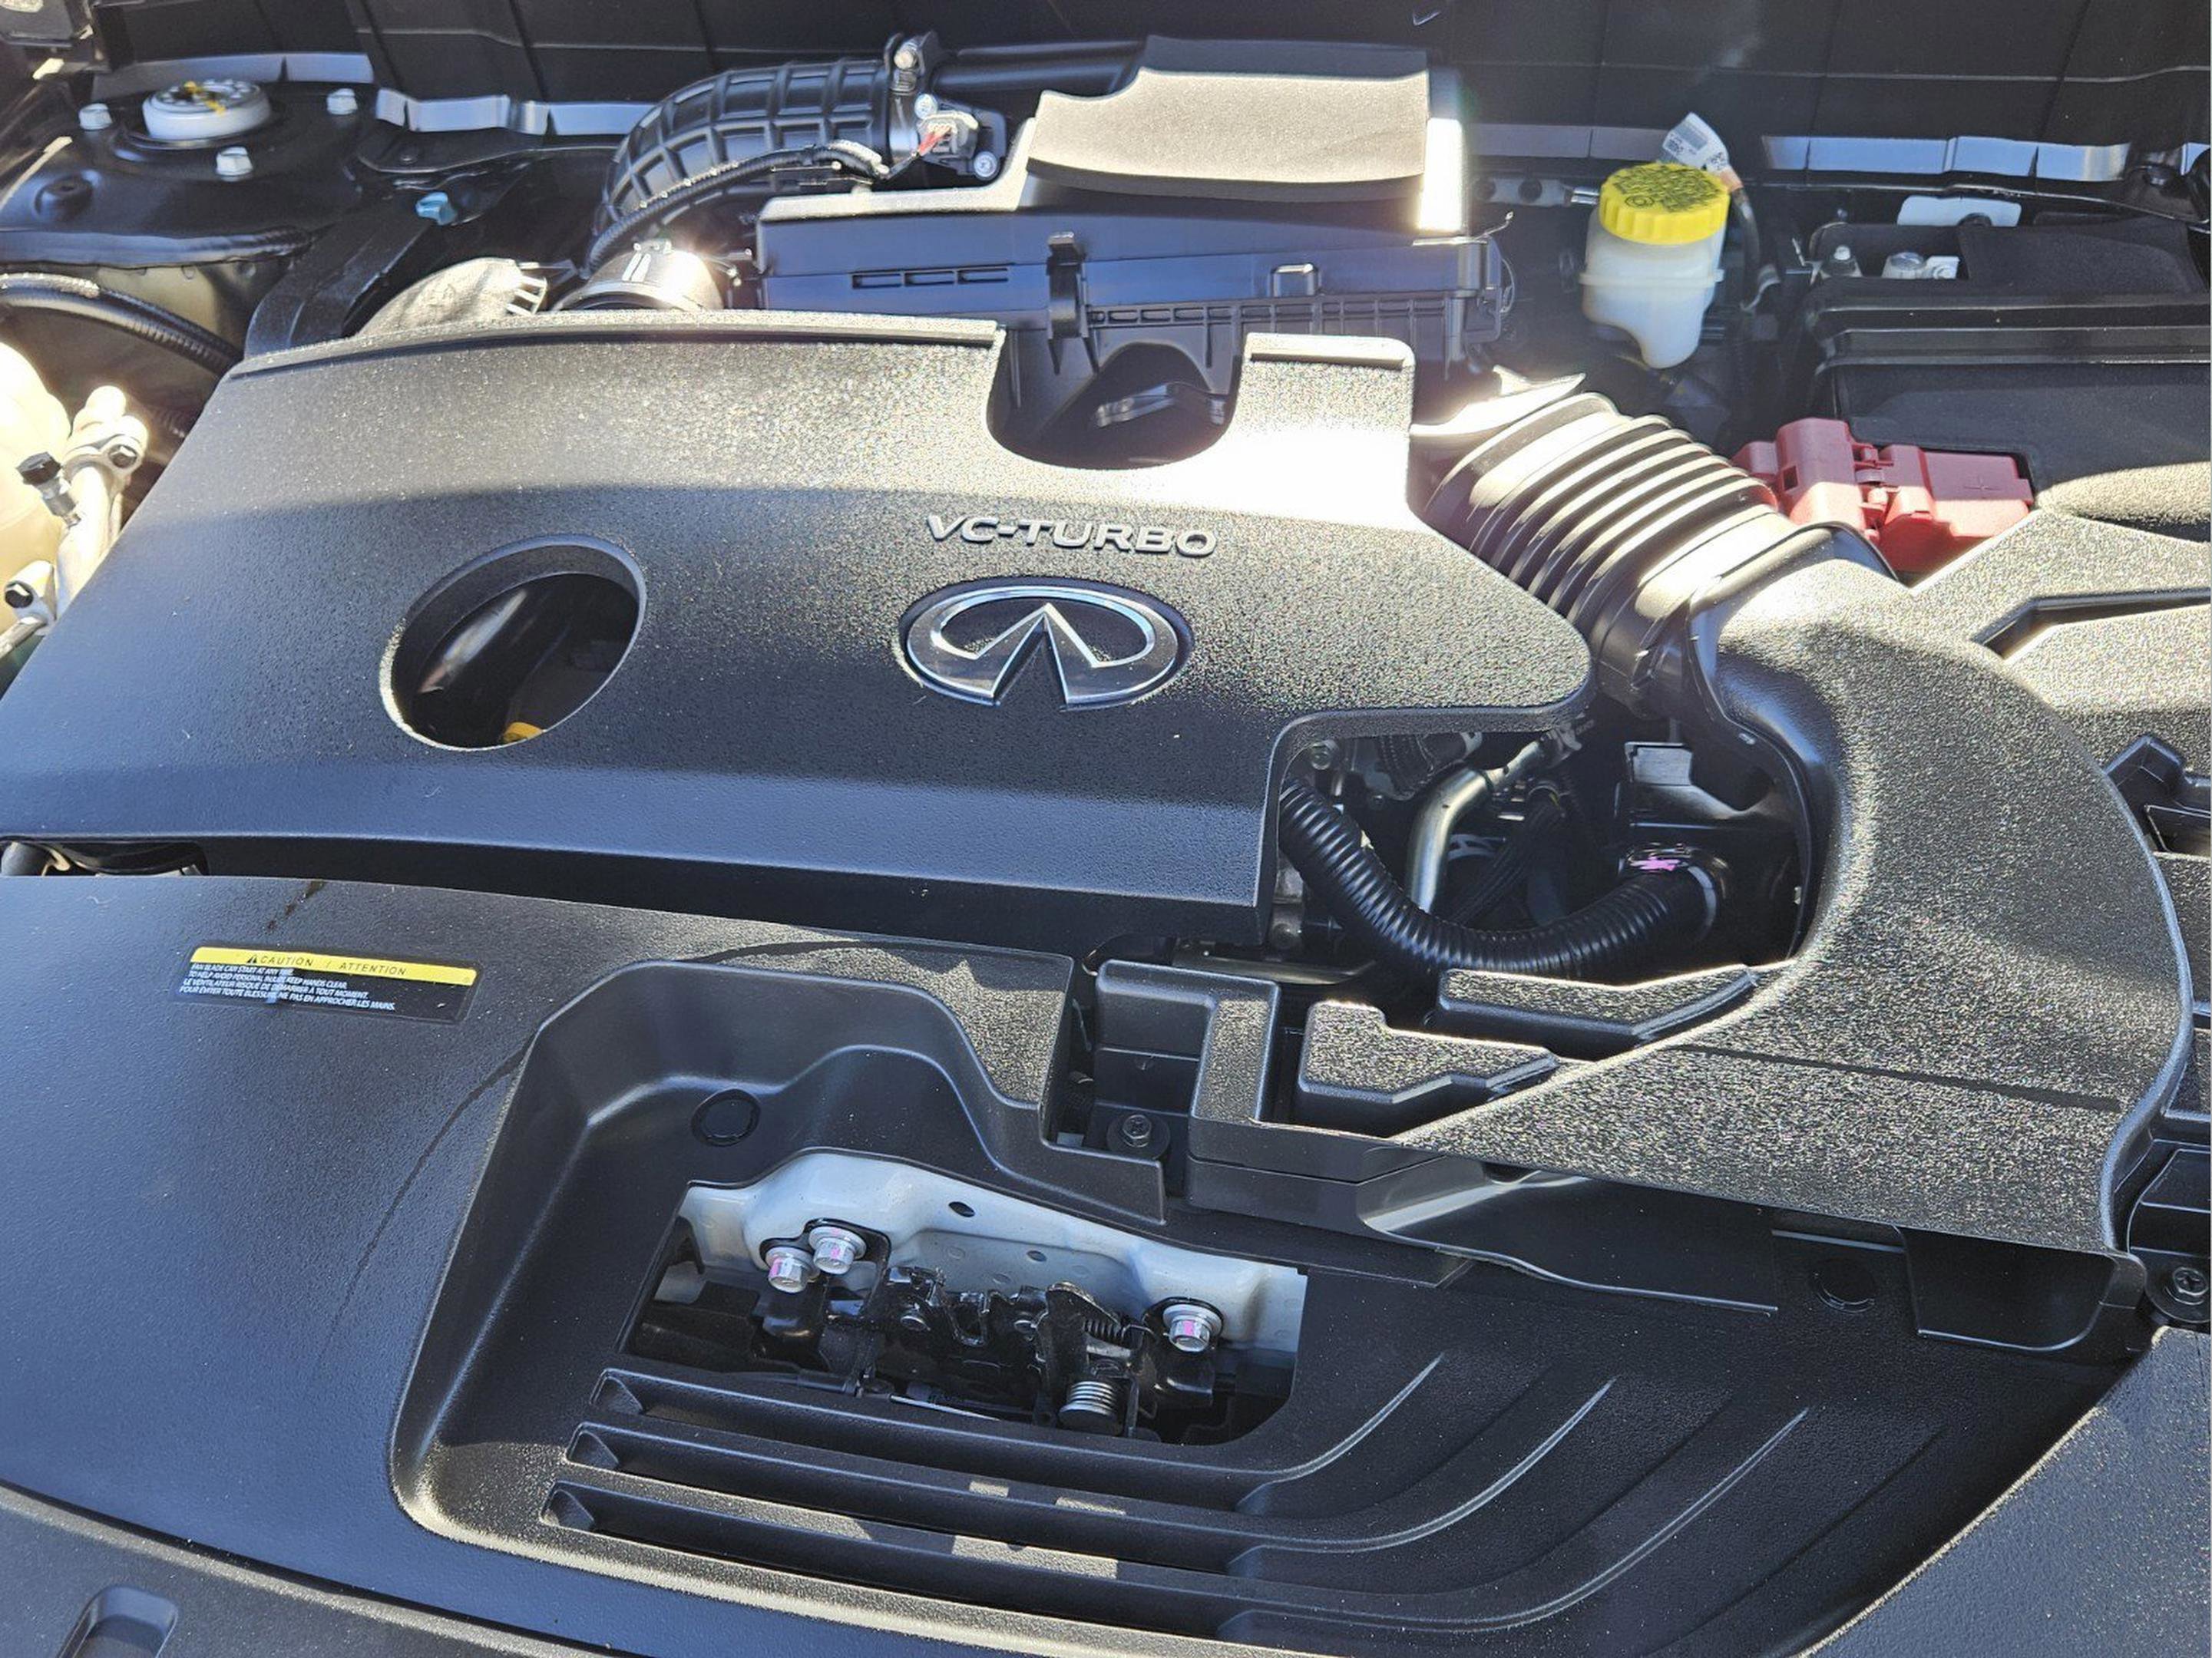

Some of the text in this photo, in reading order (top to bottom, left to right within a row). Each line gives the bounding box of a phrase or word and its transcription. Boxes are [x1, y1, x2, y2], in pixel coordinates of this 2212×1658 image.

[926, 515, 1218, 558] VC-TURBO
[260, 955, 314, 967] CAUTION
[339, 962, 407, 976] ATTENTION
[213, 972, 232, 980] AVOID
[232, 973, 263, 983] PERSONAL
[303, 978, 326, 987] HANDS
[236, 981, 260, 989] RISQUE
[316, 987, 335, 996] TOUT
[221, 989, 244, 997] TOUTE
[289, 993, 303, 1002] PAS
[303, 994, 313, 1002] EN
[313, 996, 357, 1006] APPROCHER
[356, 999, 370, 1008] LES
